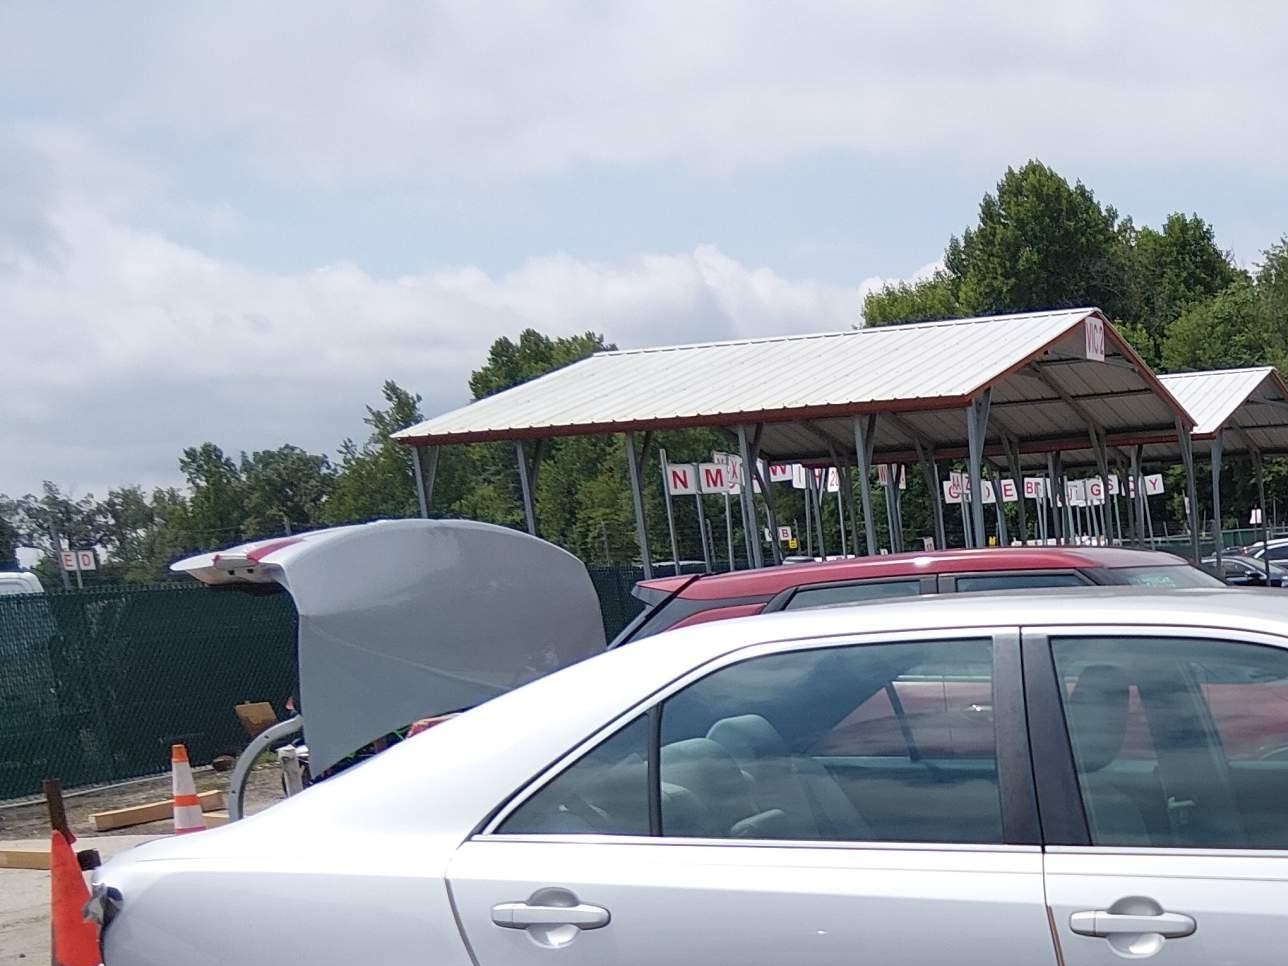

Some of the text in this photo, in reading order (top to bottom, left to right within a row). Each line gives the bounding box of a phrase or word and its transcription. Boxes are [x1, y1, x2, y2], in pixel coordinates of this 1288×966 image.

[672, 469, 689, 490] N
[704, 468, 724, 488] M
[1149, 479, 1158, 490] Y
[1003, 483, 1014, 497] E
[1026, 481, 1033, 494] B
[1090, 483, 1101, 496] G
[781, 528, 789, 538] B
[64, 554, 73, 567] E
